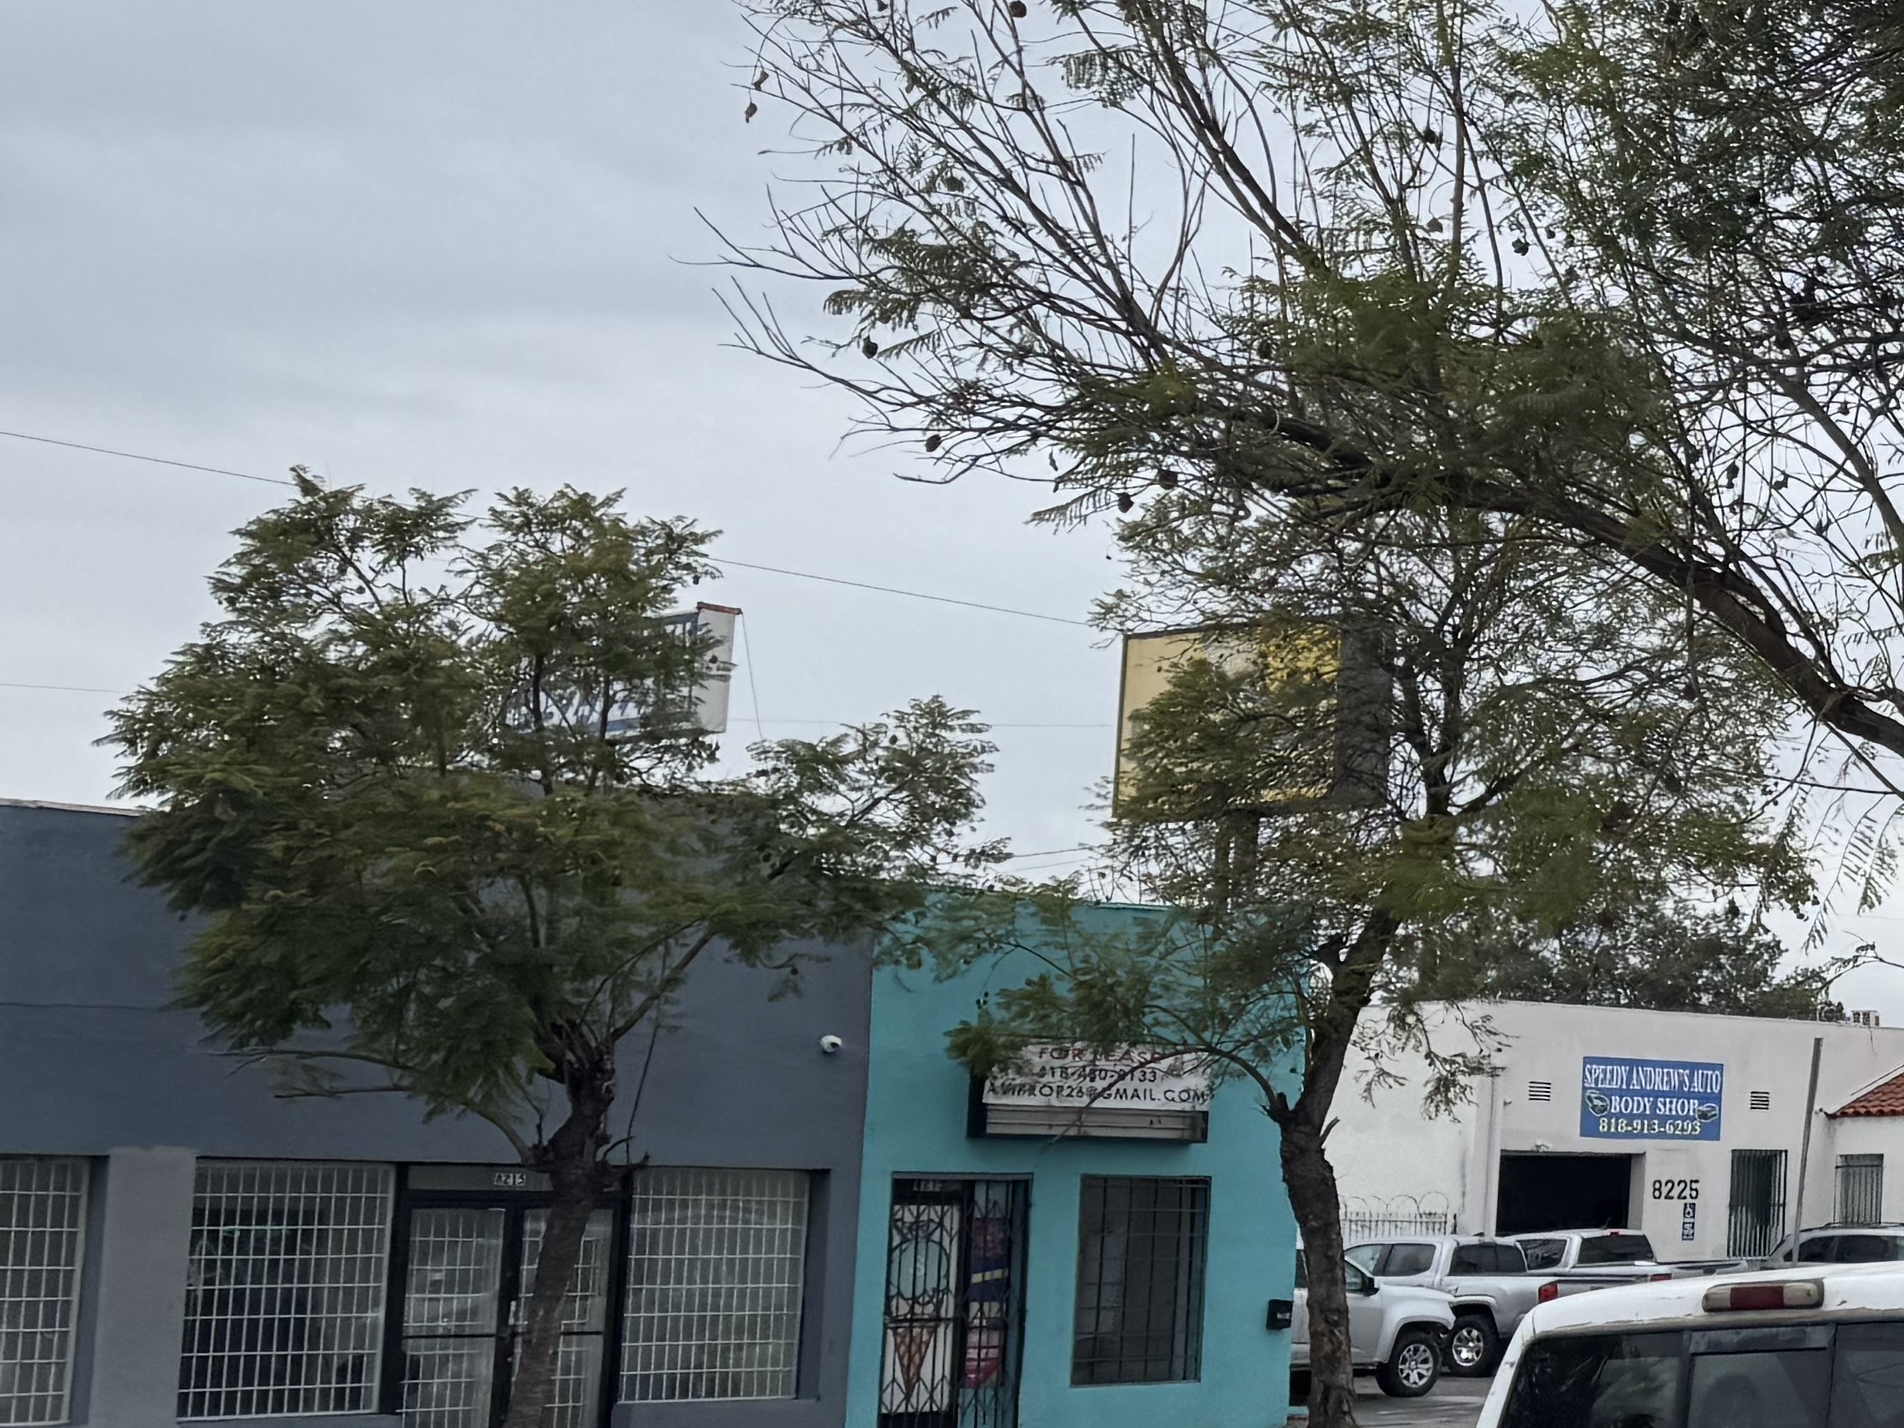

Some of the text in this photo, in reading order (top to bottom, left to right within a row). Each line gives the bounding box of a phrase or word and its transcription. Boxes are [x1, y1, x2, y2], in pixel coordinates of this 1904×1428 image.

[1584, 1064, 1721, 1094] SPEEDY ANDREW'S AUTO
[1610, 1095, 1700, 1117] BODY SHOP
[1652, 1179, 1700, 1200] 8225
